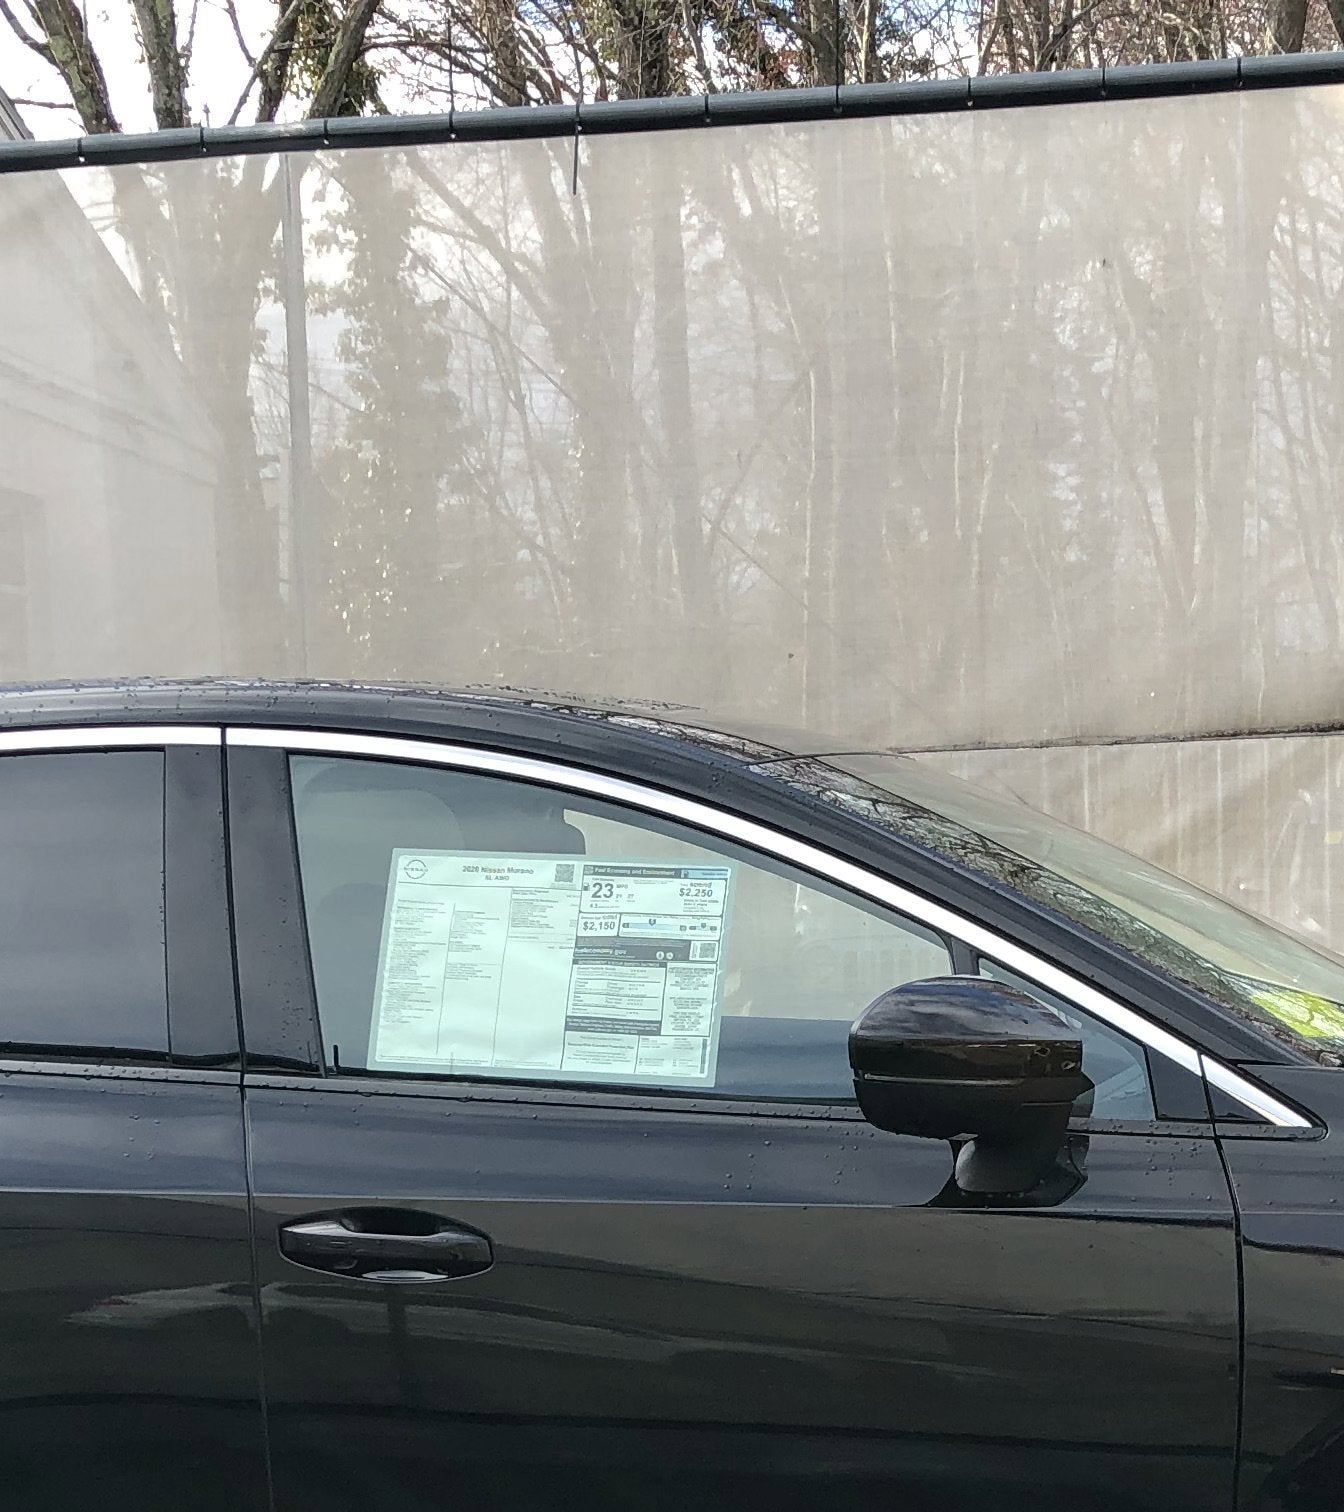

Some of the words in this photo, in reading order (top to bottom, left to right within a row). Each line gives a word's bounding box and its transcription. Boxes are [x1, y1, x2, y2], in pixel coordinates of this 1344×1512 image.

[481, 866, 505, 874] Nissan
[507, 867, 534, 875] Murano
[591, 882, 614, 899] 23
[679, 887, 713, 898] $2,250
[582, 921, 616, 931] $2,150
